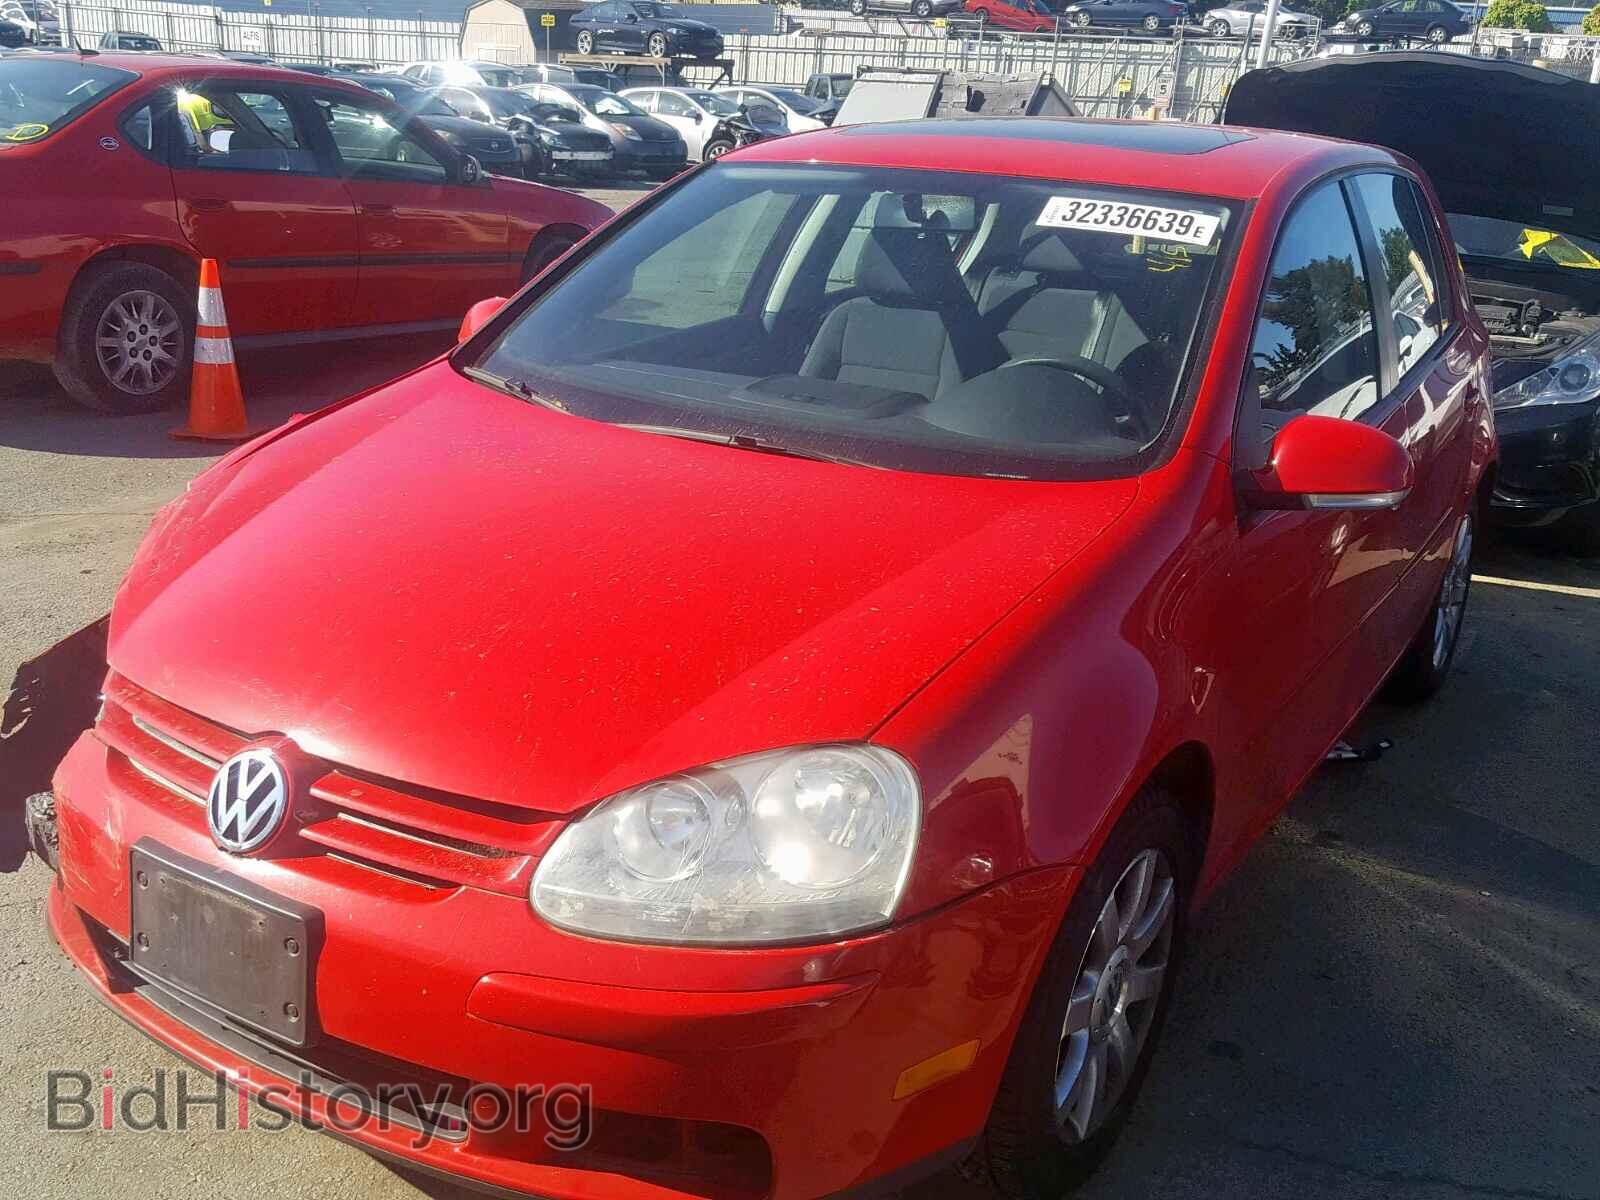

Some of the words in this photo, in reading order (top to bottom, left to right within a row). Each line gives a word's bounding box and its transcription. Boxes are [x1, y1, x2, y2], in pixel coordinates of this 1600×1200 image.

[1159, 85, 1167, 95] 5
[1062, 201, 1195, 235] 32336639
[1193, 226, 1206, 238] E
[208, 749, 284, 850] VW
